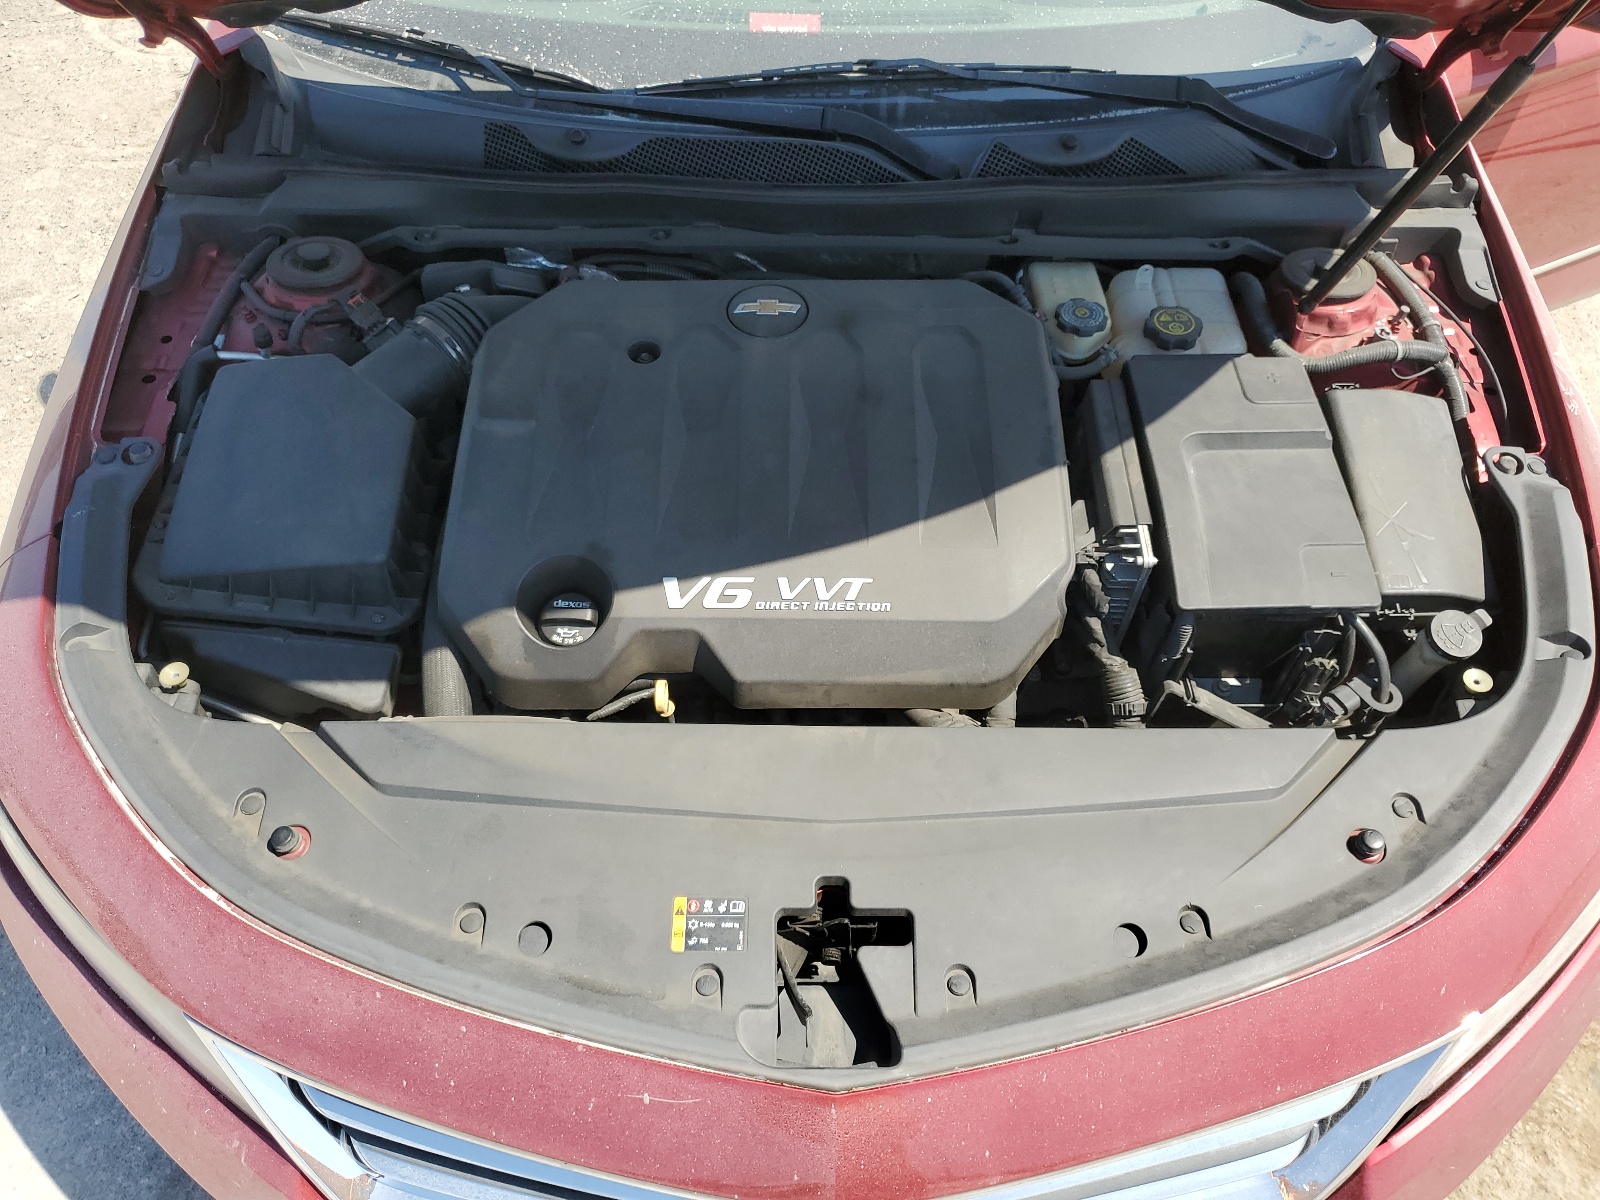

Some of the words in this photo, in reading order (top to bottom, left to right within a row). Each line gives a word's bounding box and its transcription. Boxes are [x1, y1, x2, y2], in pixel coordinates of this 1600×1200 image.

[662, 576, 756, 610] V6
[776, 576, 875, 602] VVT
[553, 599, 590, 608] dexos
[754, 601, 811, 612] DIRECT
[813, 601, 892, 613] INJECTION
